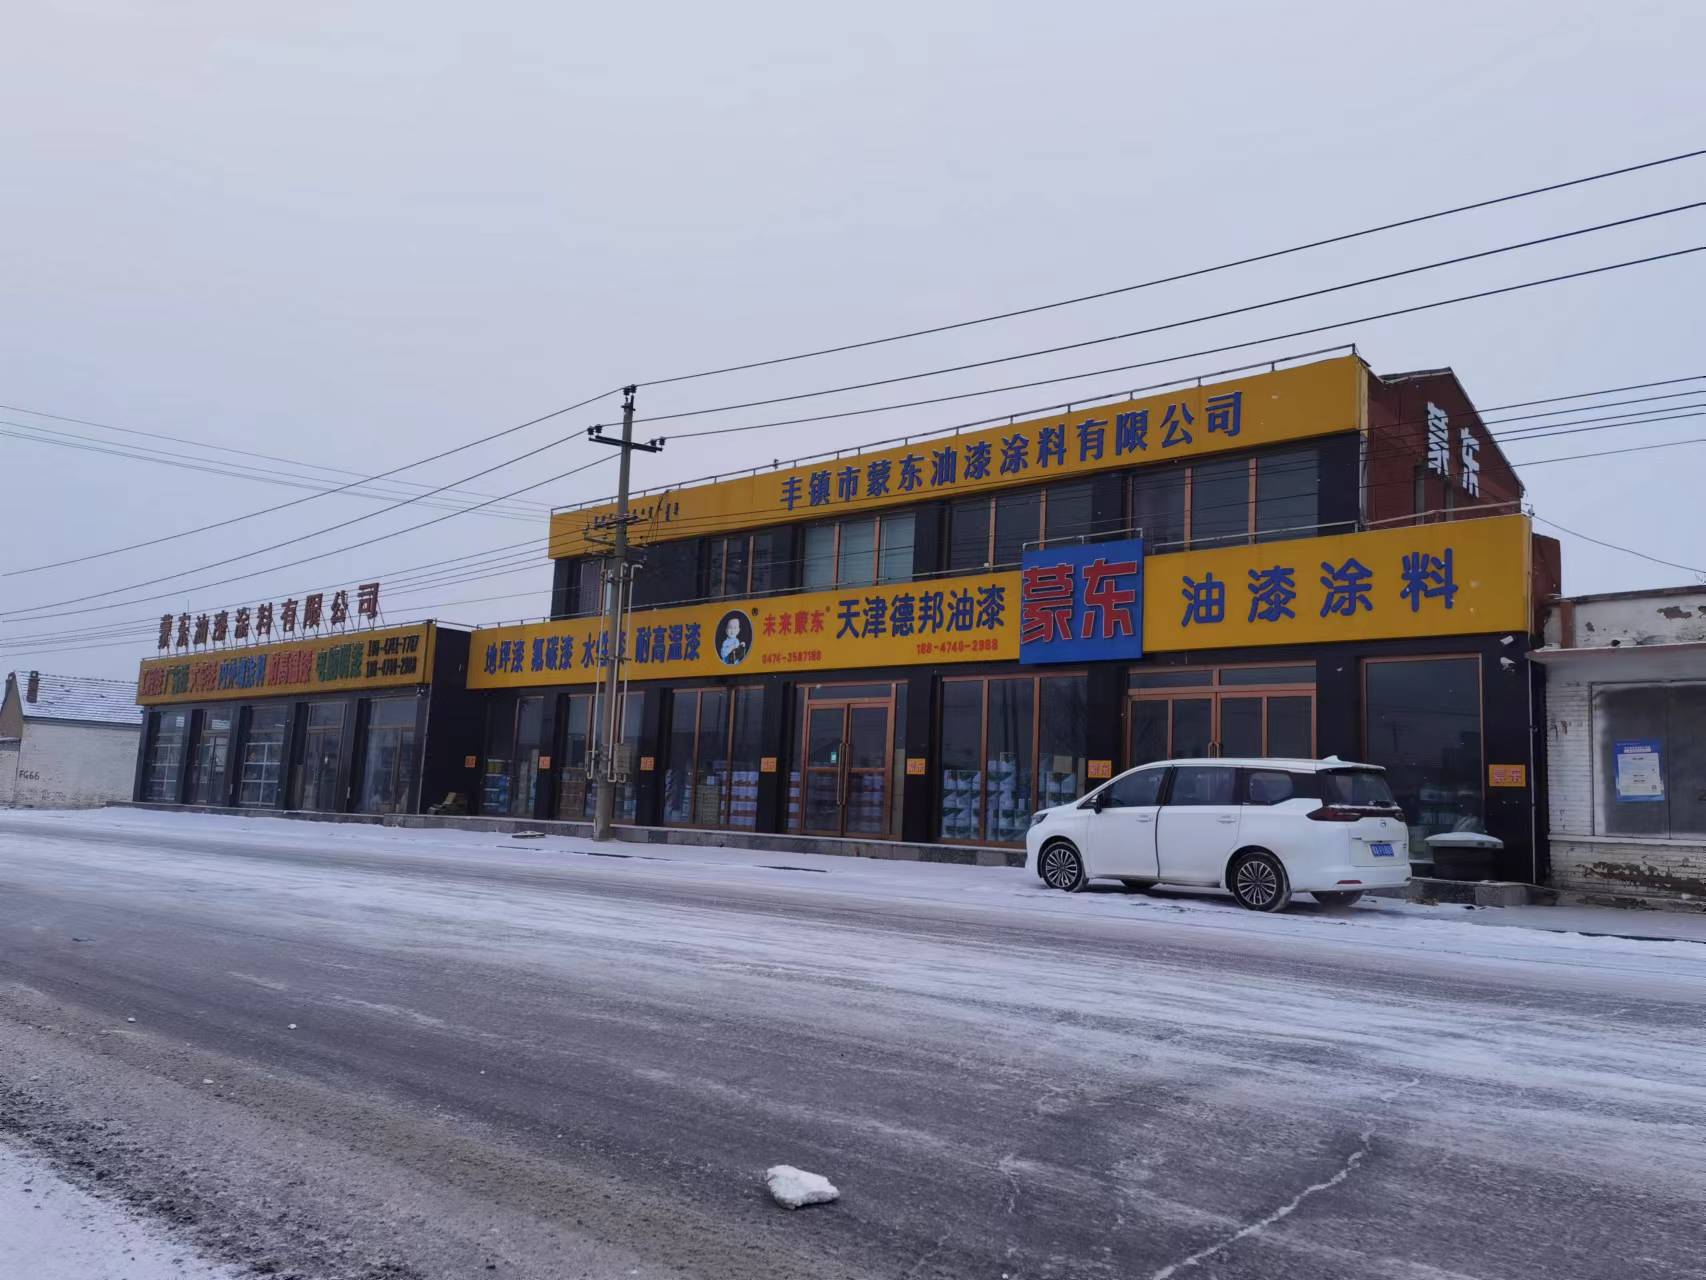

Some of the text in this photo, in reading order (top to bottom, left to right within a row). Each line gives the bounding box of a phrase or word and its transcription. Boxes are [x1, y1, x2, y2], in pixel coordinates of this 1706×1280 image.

[780, 391, 1242, 511] 丰镇市蒙东油漆涂料有限公司
[835, 584, 1007, 640] 天津德邦油漆
[1020, 557, 1139, 644] 蒙东
[1180, 547, 1460, 627] 油漆涂料
[484, 639, 525, 675] 地坪漆
[635, 622, 701, 663] 耐高温漆
[762, 609, 825, 637] 未来蒙东
